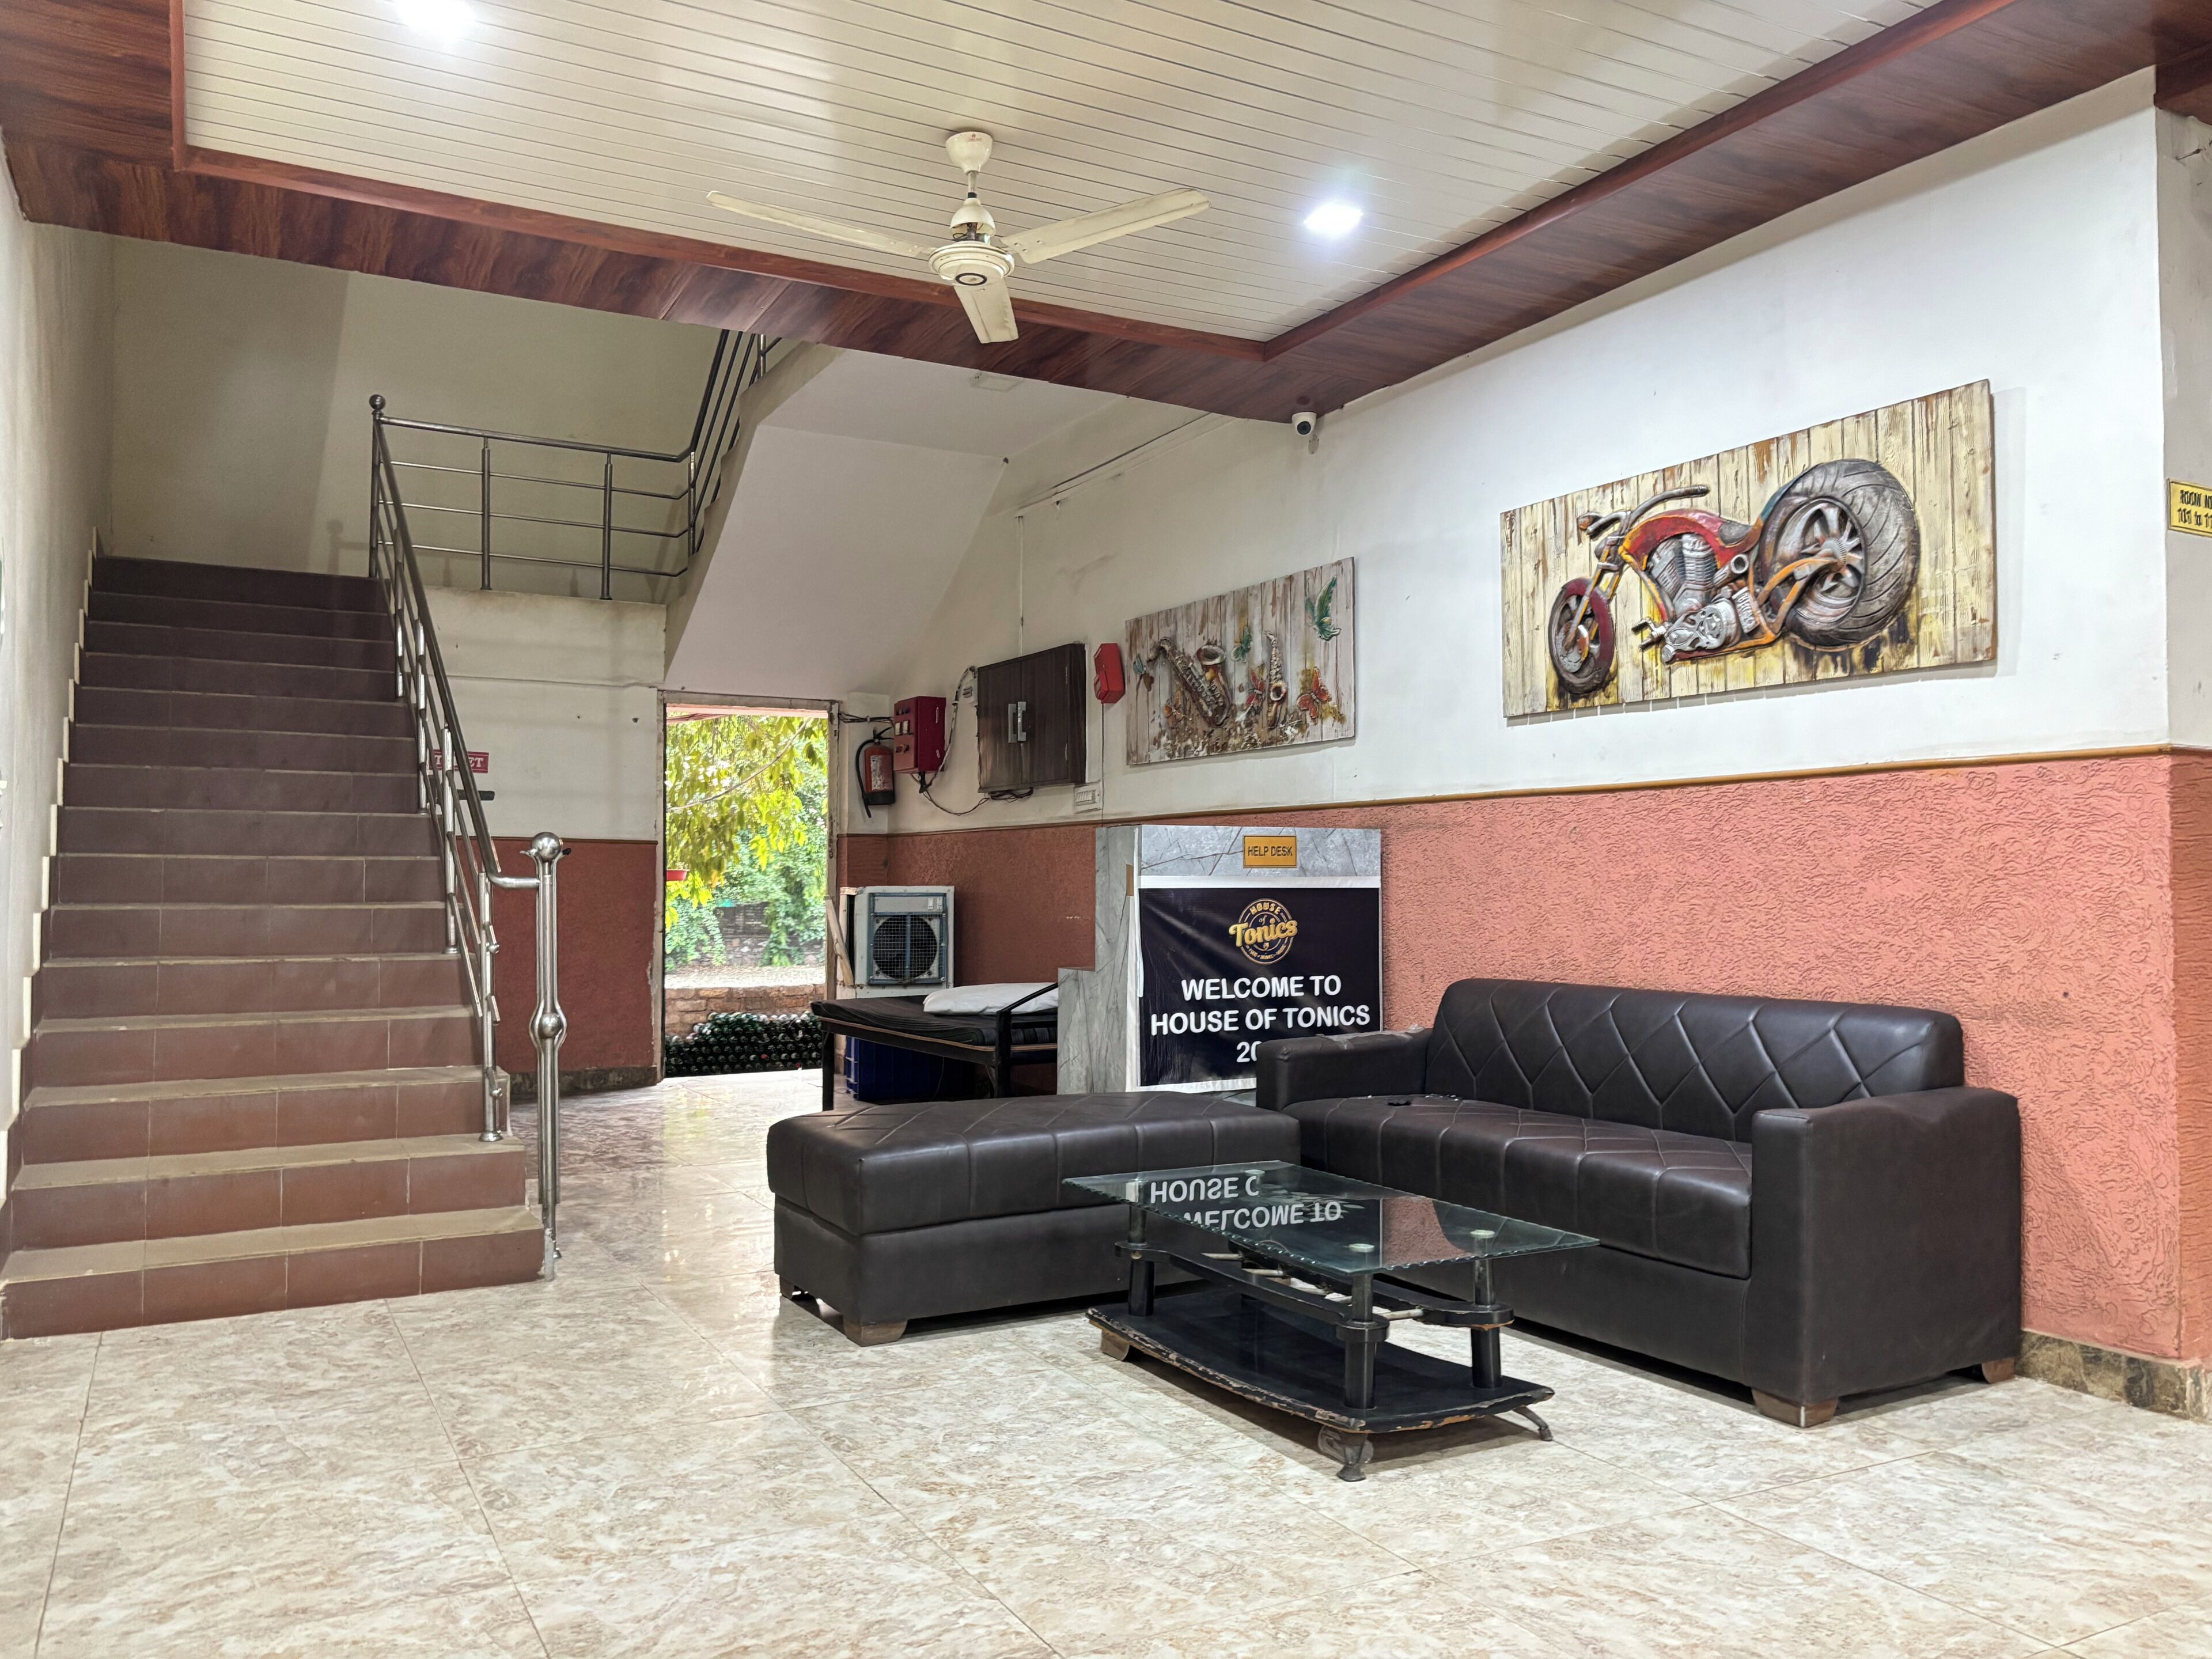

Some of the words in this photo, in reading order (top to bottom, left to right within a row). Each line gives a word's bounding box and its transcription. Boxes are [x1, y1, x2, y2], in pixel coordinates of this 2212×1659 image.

[2194, 511, 2203, 526] to
[1248, 846, 1269, 857] HELP
[1271, 846, 1293, 857] DESK
[1249, 902, 1282, 915] HOUSE
[1259, 915, 1267, 926] of
[1229, 920, 1298, 948] Tonics
[1181, 976, 1304, 1001] WELCOME
[1309, 975, 1341, 997] TO
[1151, 1009, 1240, 1036] HOUSE
[1245, 1008, 1278, 1030] OF
[1282, 1005, 1370, 1029] TONICS
